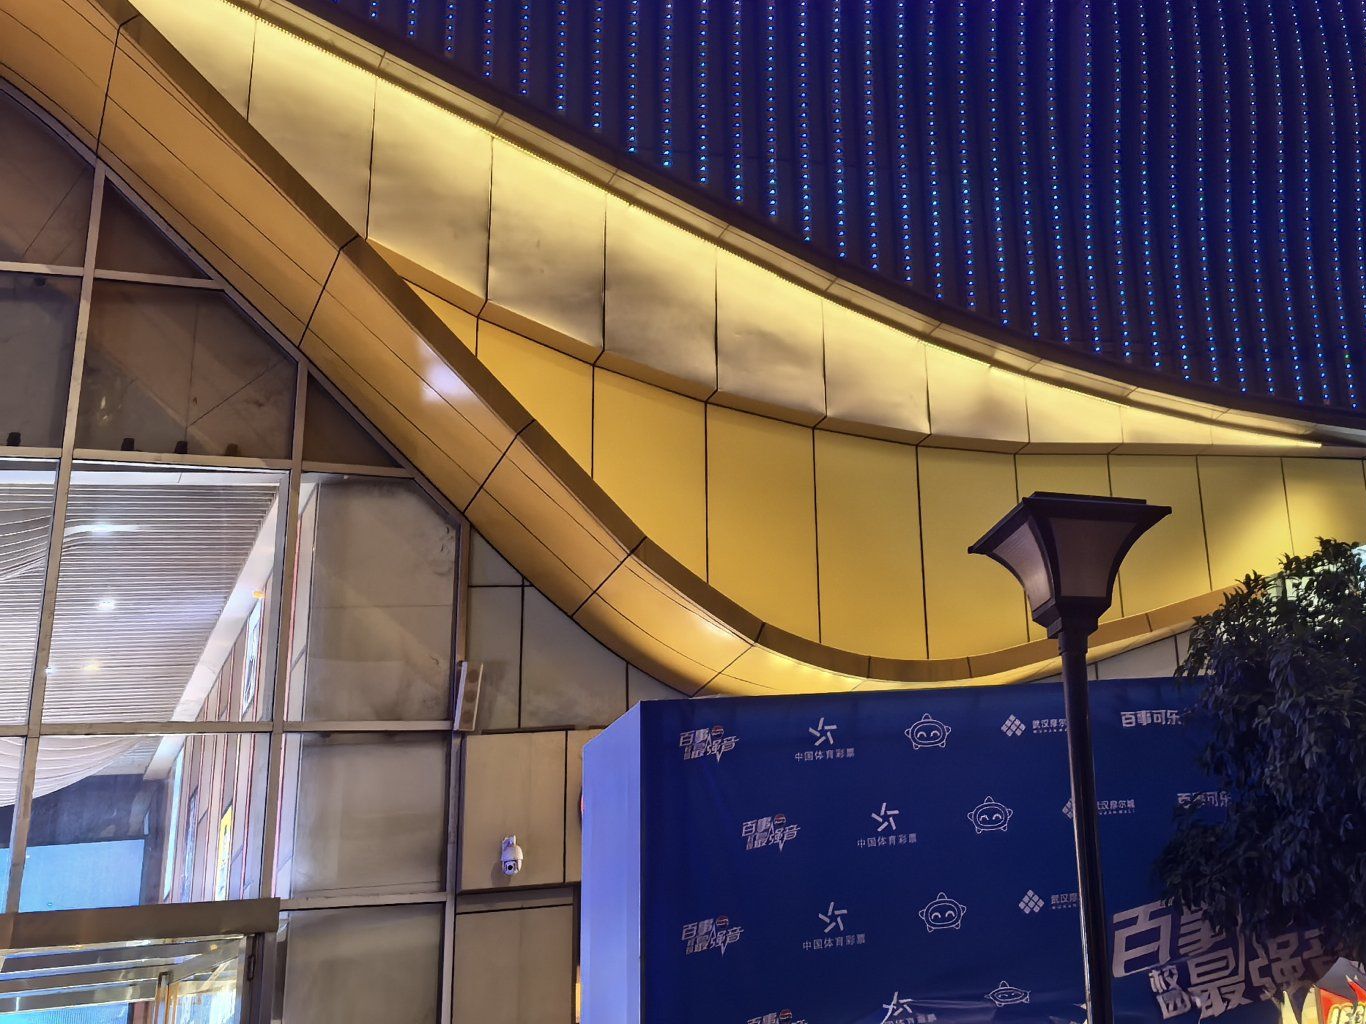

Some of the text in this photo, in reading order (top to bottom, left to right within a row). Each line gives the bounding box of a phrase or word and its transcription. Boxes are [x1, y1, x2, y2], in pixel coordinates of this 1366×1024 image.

[1120, 709, 1182, 728] 百事可乐
[794, 748, 856, 763] 中国体育彩票
[856, 833, 917, 849] 中国体育彩票
[802, 933, 866, 951] 中国体育彩票
